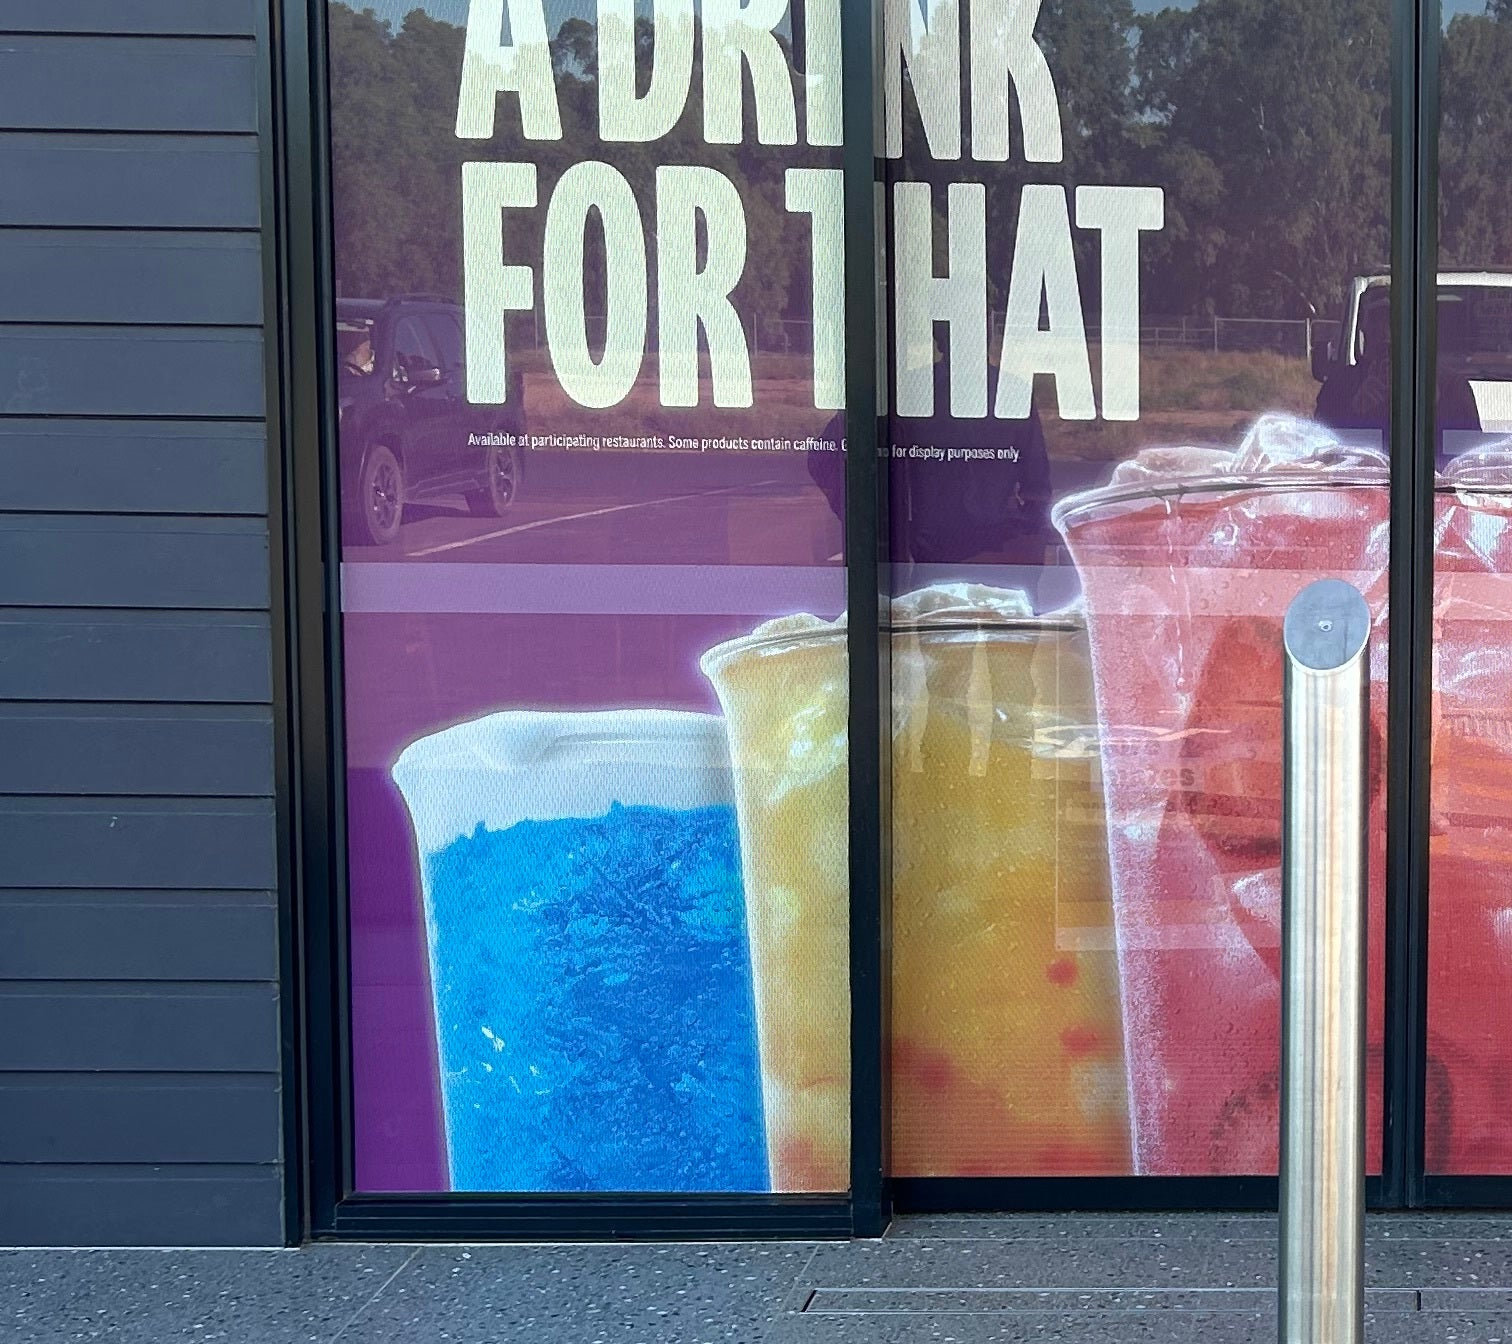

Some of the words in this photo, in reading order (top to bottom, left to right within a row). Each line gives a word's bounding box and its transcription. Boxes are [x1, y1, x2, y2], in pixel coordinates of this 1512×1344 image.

[462, 160, 754, 409] FOR
[785, 168, 1165, 422] THAT
[468, 432, 516, 447] Available
[518, 435, 529, 447] at
[531, 434, 600, 451] participating
[602, 436, 665, 449] restaurants.
[668, 435, 699, 449] Some
[701, 436, 749, 452] products
[751, 437, 791, 451] contain
[892, 444, 907, 458] for
[909, 445, 945, 462] display
[947, 447, 995, 463] purposes
